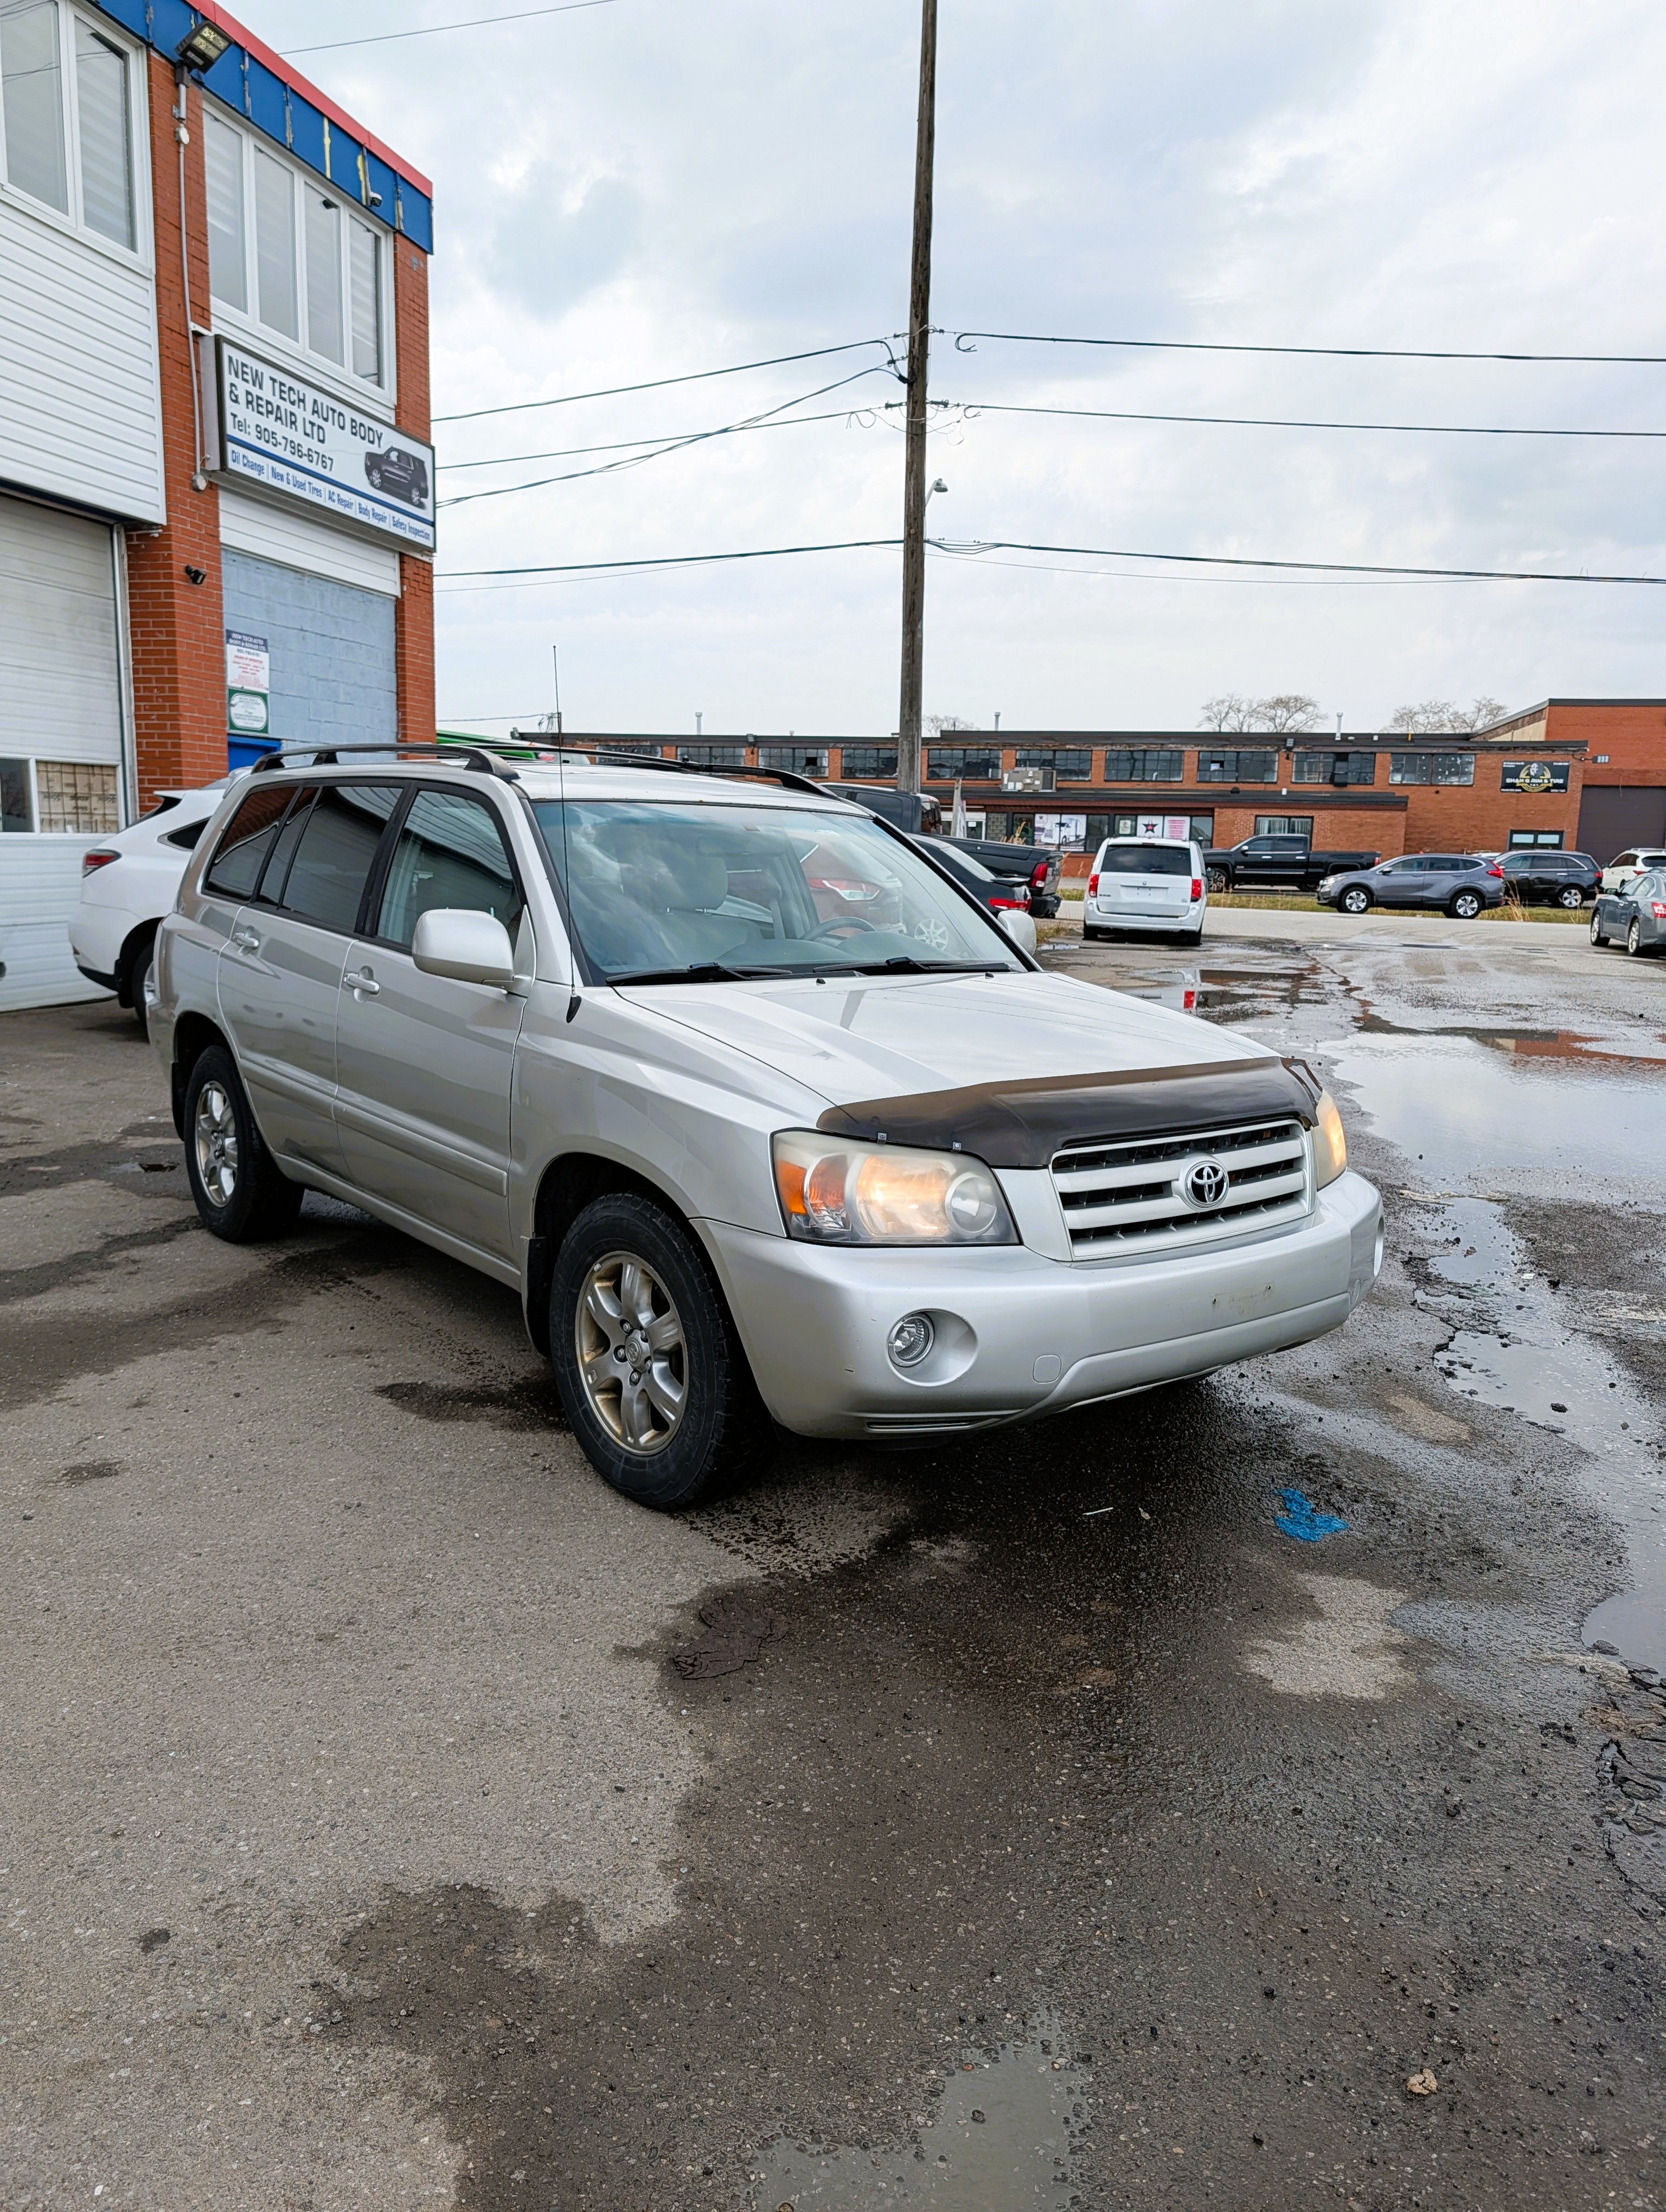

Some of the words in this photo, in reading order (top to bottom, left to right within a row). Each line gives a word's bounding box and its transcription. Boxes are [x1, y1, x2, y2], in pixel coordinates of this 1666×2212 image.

[228, 354, 264, 390] NEW
[269, 375, 307, 412] TECH
[312, 398, 345, 431] AUTO
[350, 417, 383, 448] BODY
[229, 382, 240, 405] &
[246, 389, 298, 432] REPAIR
[303, 417, 326, 444] LTD
[230, 411, 251, 435] Tel:
[255, 423, 334, 472] 905-796-6767
[231, 449, 240, 465] Oil
[242, 454, 265, 476] Change
[272, 466, 284, 482] New
[286, 472, 291, 485] &
[293, 474, 306, 491] Used
[307, 481, 322, 498] Tires
[328, 490, 336, 503] AC
[337, 493, 354, 510] Repair
[358, 502, 370, 519] Body
[372, 507, 387, 524] Repair
[392, 516, 407, 533] Safety
[408, 522, 431, 541] Inspection
